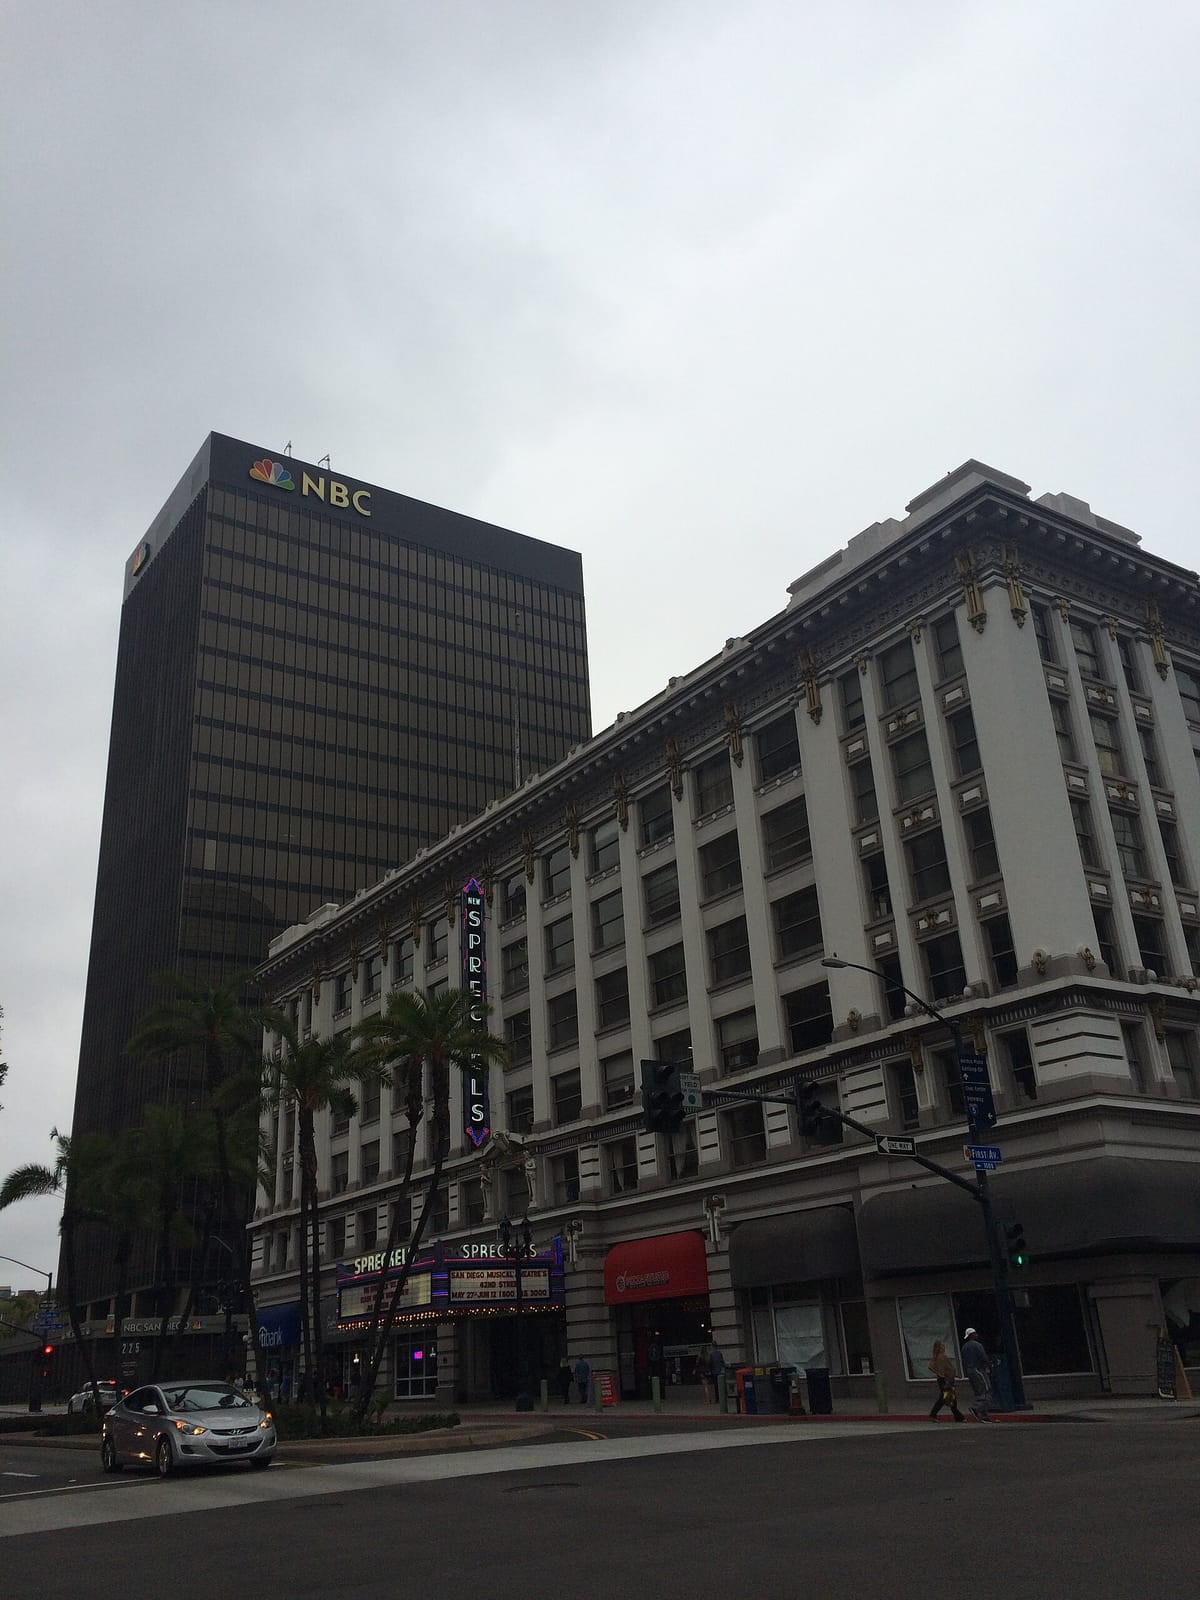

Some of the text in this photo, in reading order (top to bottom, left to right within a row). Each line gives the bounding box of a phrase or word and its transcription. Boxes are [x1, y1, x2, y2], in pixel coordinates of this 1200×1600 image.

[302, 472, 371, 516] NBC
[468, 897, 481, 906] NEW
[451, 1271, 465, 1279] SAN
[466, 1271, 485, 1279] DIEGO
[486, 1271, 514, 1279] MUSICAL
[452, 1291, 465, 1299] MAY
[123, 1322, 142, 1332] NBC
[143, 1322, 161, 1332] SAN
[121, 1342, 140, 1354] 225
